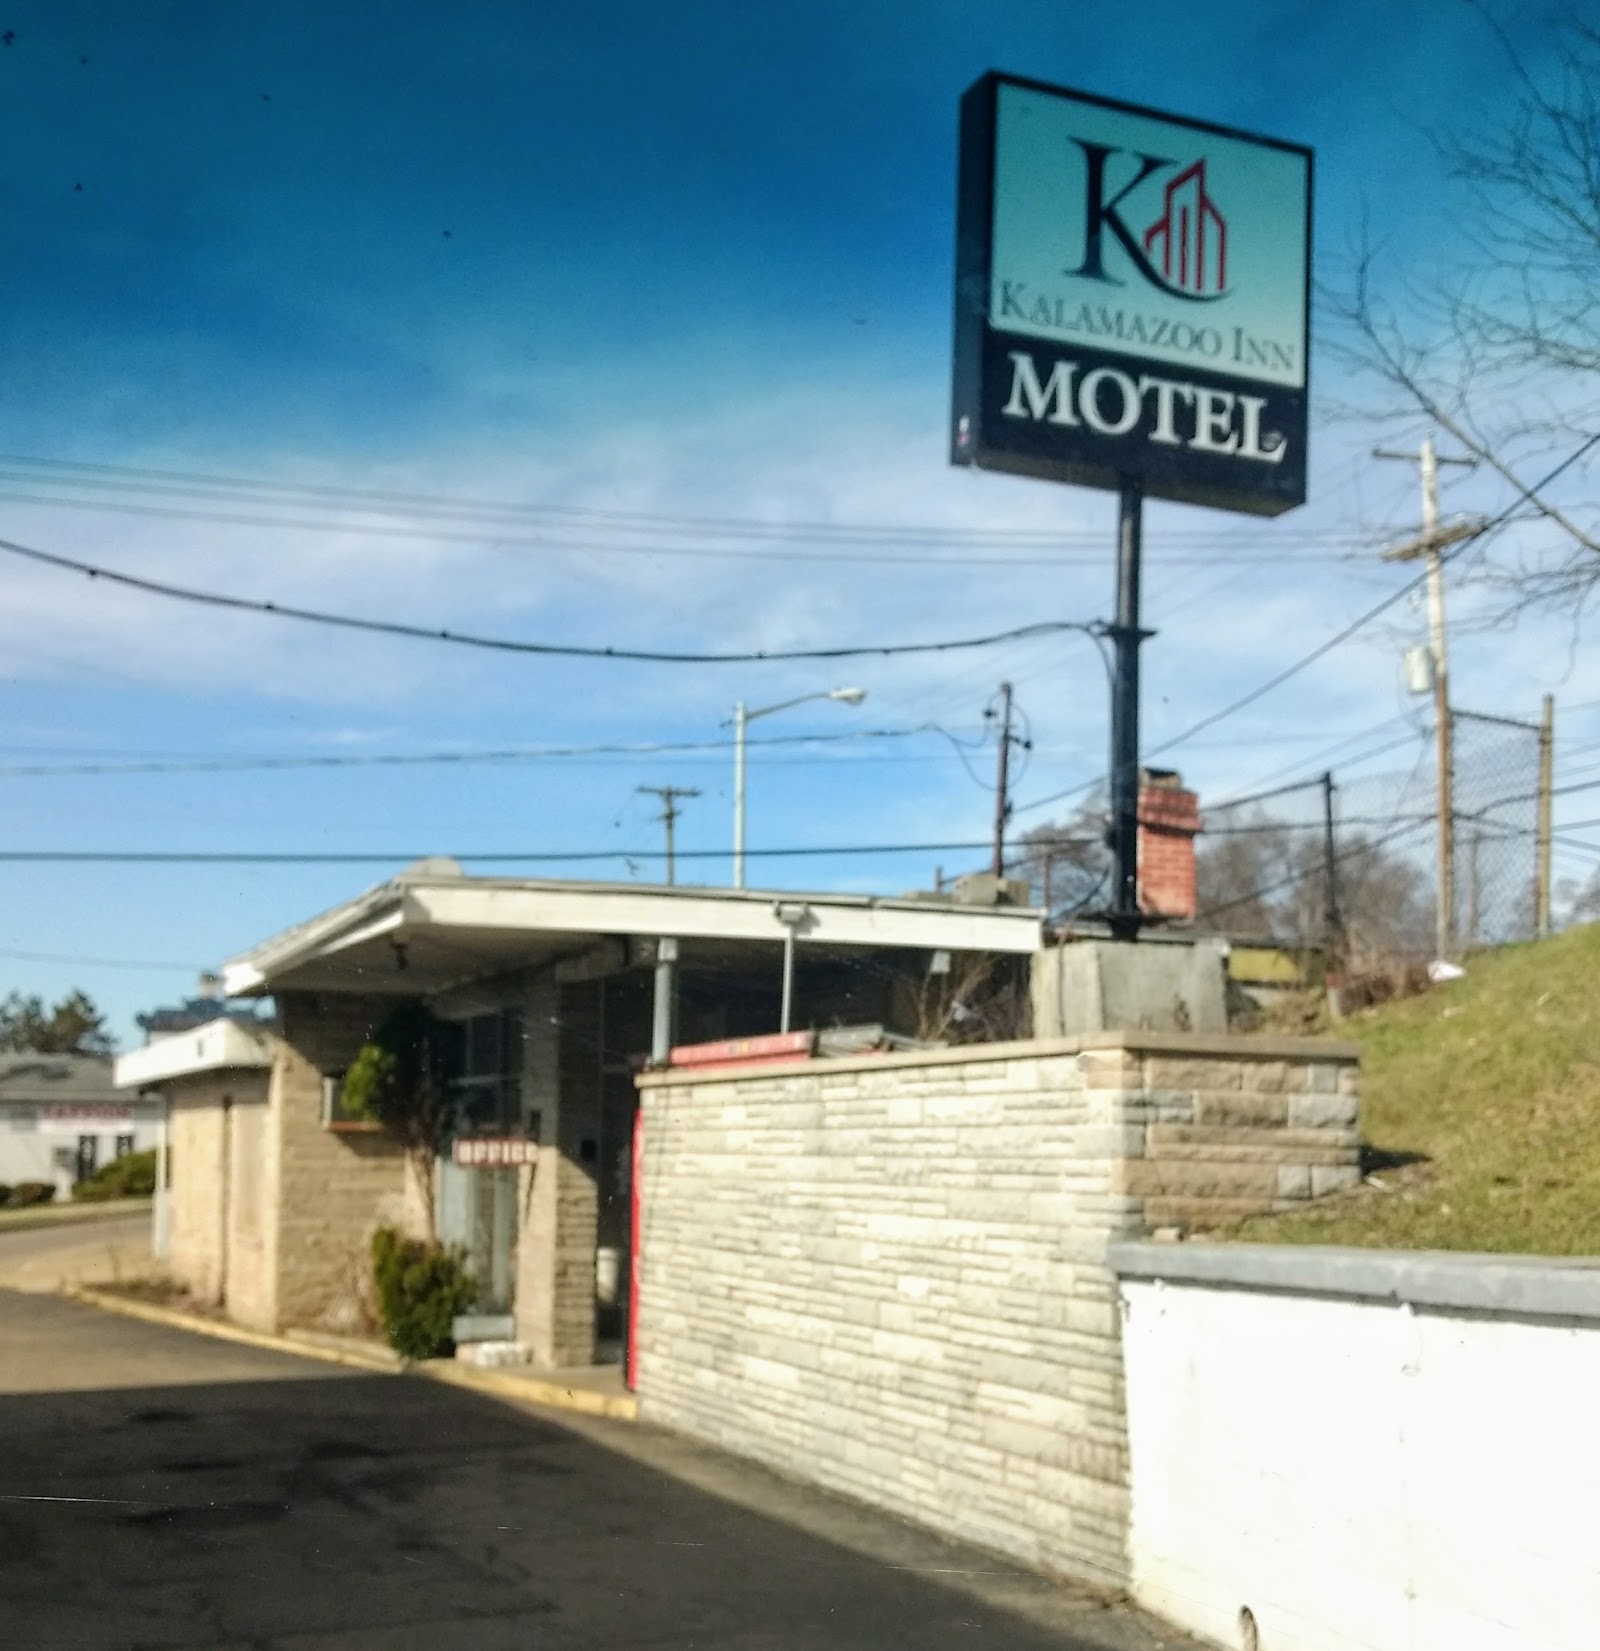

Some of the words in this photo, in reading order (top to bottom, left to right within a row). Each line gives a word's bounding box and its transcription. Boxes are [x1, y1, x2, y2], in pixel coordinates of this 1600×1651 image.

[1063, 136, 1231, 302] K
[1001, 281, 1222, 353] KALAMAZOO
[1232, 327, 1294, 371] INN
[1003, 352, 1286, 463] MOTEL
